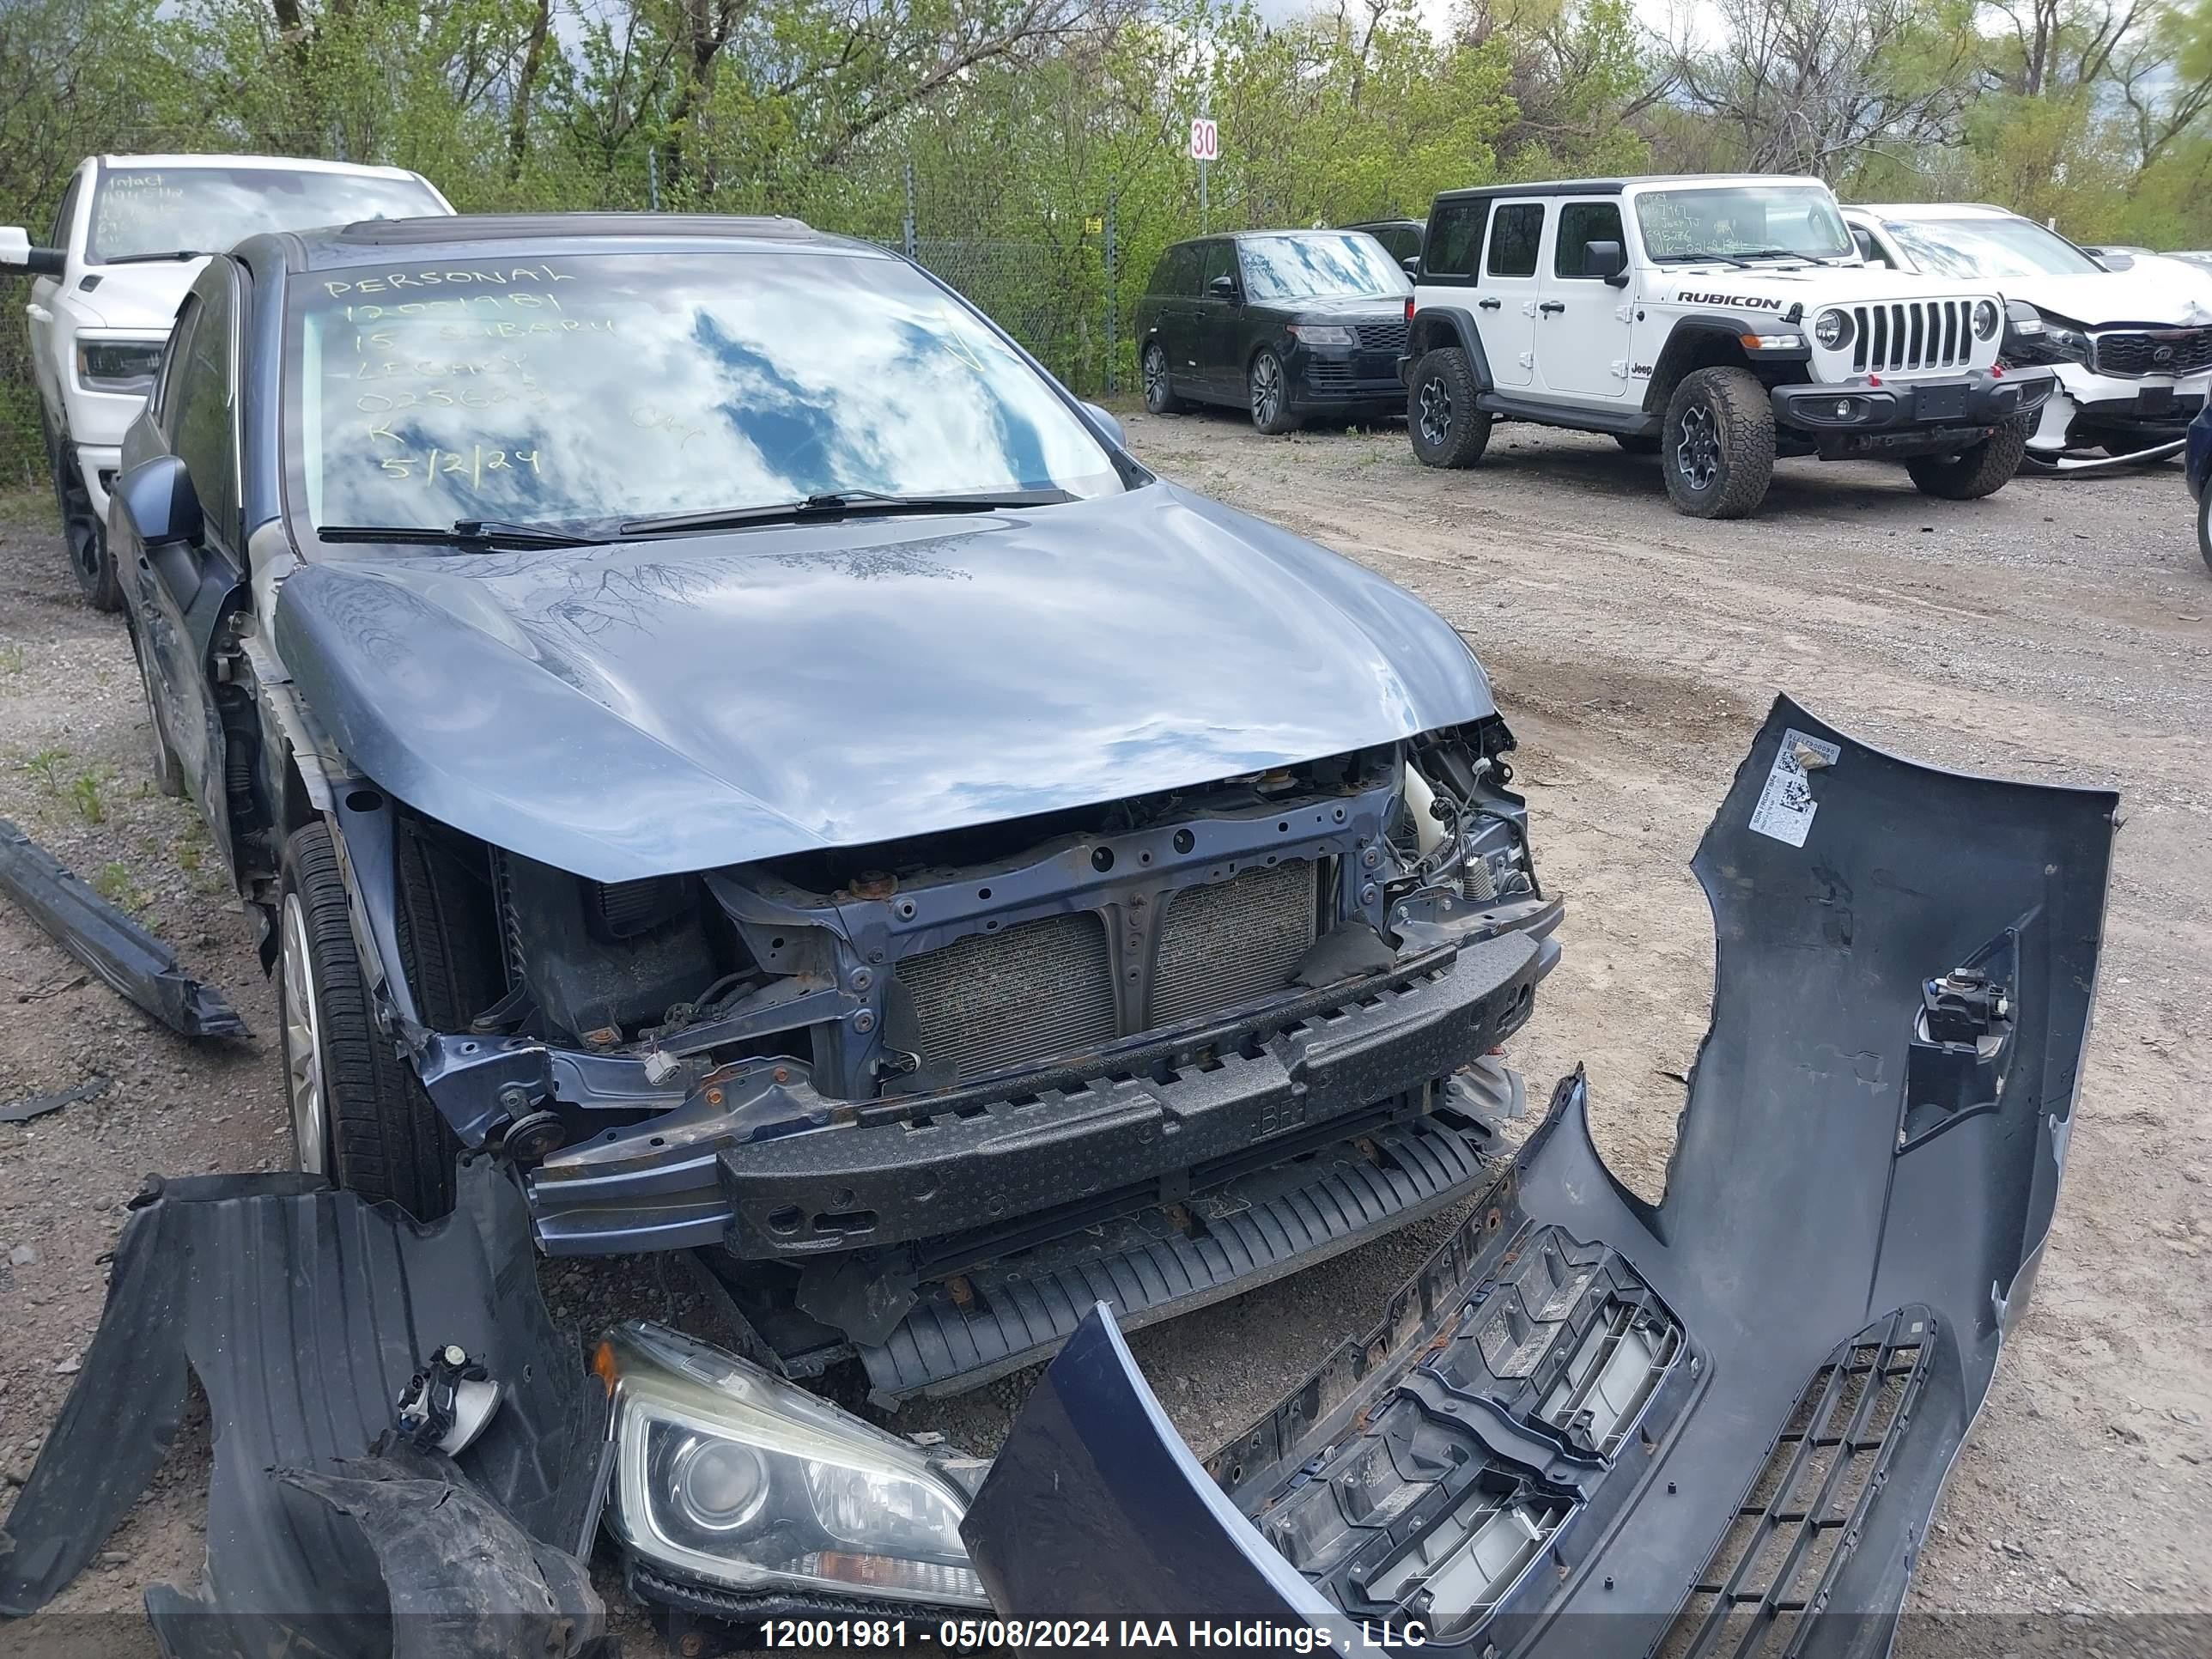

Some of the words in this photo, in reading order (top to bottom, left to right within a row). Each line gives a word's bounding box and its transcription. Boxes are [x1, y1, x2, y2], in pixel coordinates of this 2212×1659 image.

[1194, 123, 1215, 155] 30
[324, 265, 576, 298] PERSONAL
[1678, 291, 1783, 310] RUBICON
[1632, 362, 1653, 375] Jeep
[381, 445, 543, 492] 5/2/24
[1759, 786, 1772, 810] FRONT
